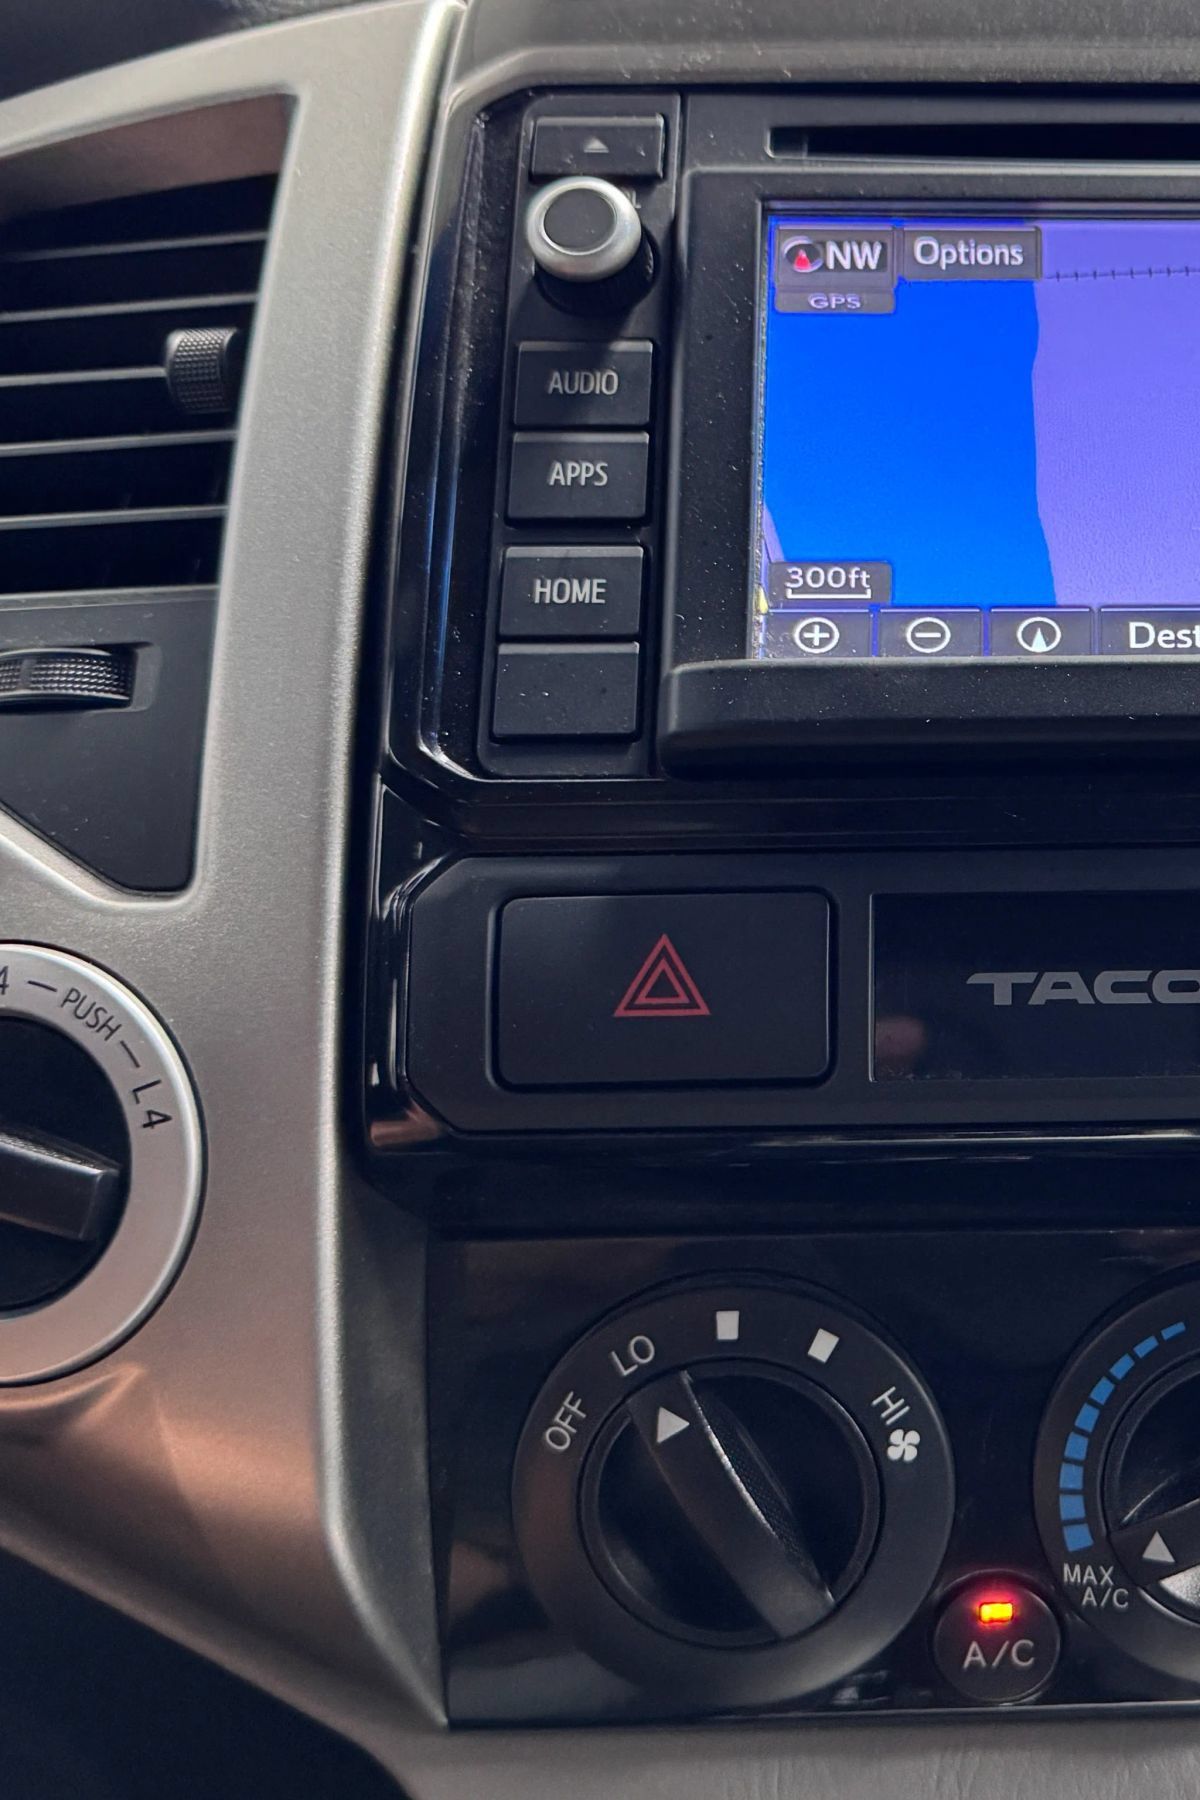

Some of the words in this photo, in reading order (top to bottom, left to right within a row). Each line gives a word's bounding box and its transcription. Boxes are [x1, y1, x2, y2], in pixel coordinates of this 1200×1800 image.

[826, 242, 882, 271] NW
[914, 236, 1024, 270] Options
[808, 294, 861, 310] GPS
[547, 369, 619, 397] AUDIO
[549, 460, 610, 488] APPS
[533, 578, 607, 605] HOME
[785, 566, 871, 589] 300ft
[60, 987, 122, 1042] PUSH
[609, 1334, 656, 1379] LO
[871, 1385, 914, 1428] HI
[543, 1390, 589, 1454] OFF
[1062, 1563, 1116, 1586] MAX
[1082, 1587, 1130, 1609] A/C
[962, 1638, 1036, 1669] A/C
